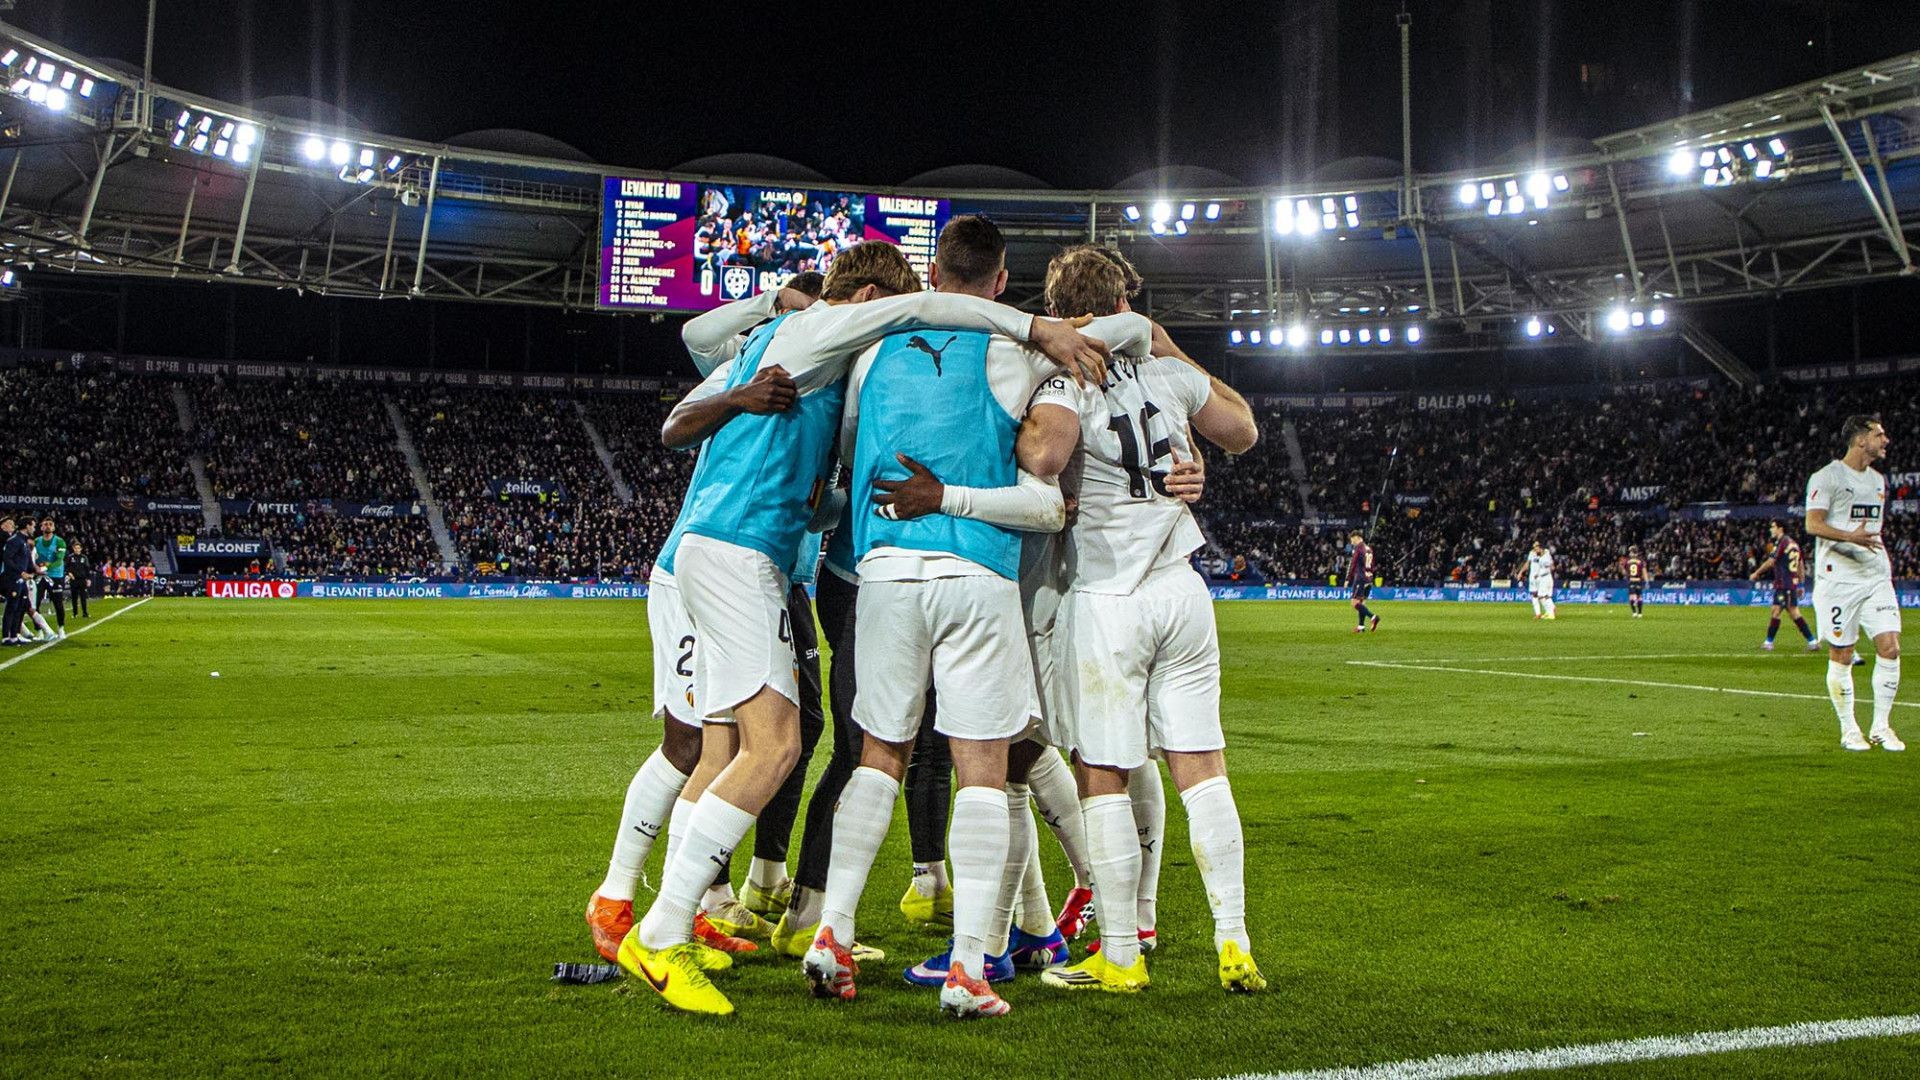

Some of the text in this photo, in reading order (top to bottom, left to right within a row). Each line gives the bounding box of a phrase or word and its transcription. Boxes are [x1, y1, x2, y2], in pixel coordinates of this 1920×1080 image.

[621, 180, 680, 199] LEVANTE UD
[761, 191, 792, 202] LALIGA
[878, 197, 938, 215] VALENCIA CF
[506, 481, 541, 494] teika
[1620, 485, 1667, 501] AMST
[18, 496, 50, 504] PORTE
[52, 497, 65, 505] AL
[67, 498, 88, 506] COR
[197, 543, 260, 554] RACONET
[212, 582, 273, 598] LALIGA
[326, 586, 442, 598] LEVANTE BLAU HOME
[483, 585, 519, 598] Family
[586, 587, 649, 597] LEVANTE BLA
[1278, 590, 1316, 600] LEVANTE
[1318, 590, 1340, 600] BLAU
[1466, 591, 1495, 601] LEVANTE
[1496, 591, 1514, 601] BLAU
[1680, 594, 1701, 604] BLAU
[1702, 594, 1730, 604] HOME
[1902, 595, 1920, 606] BLA
[1832, 607, 1842, 624] 2
[1138, 826, 1150, 836] CF
